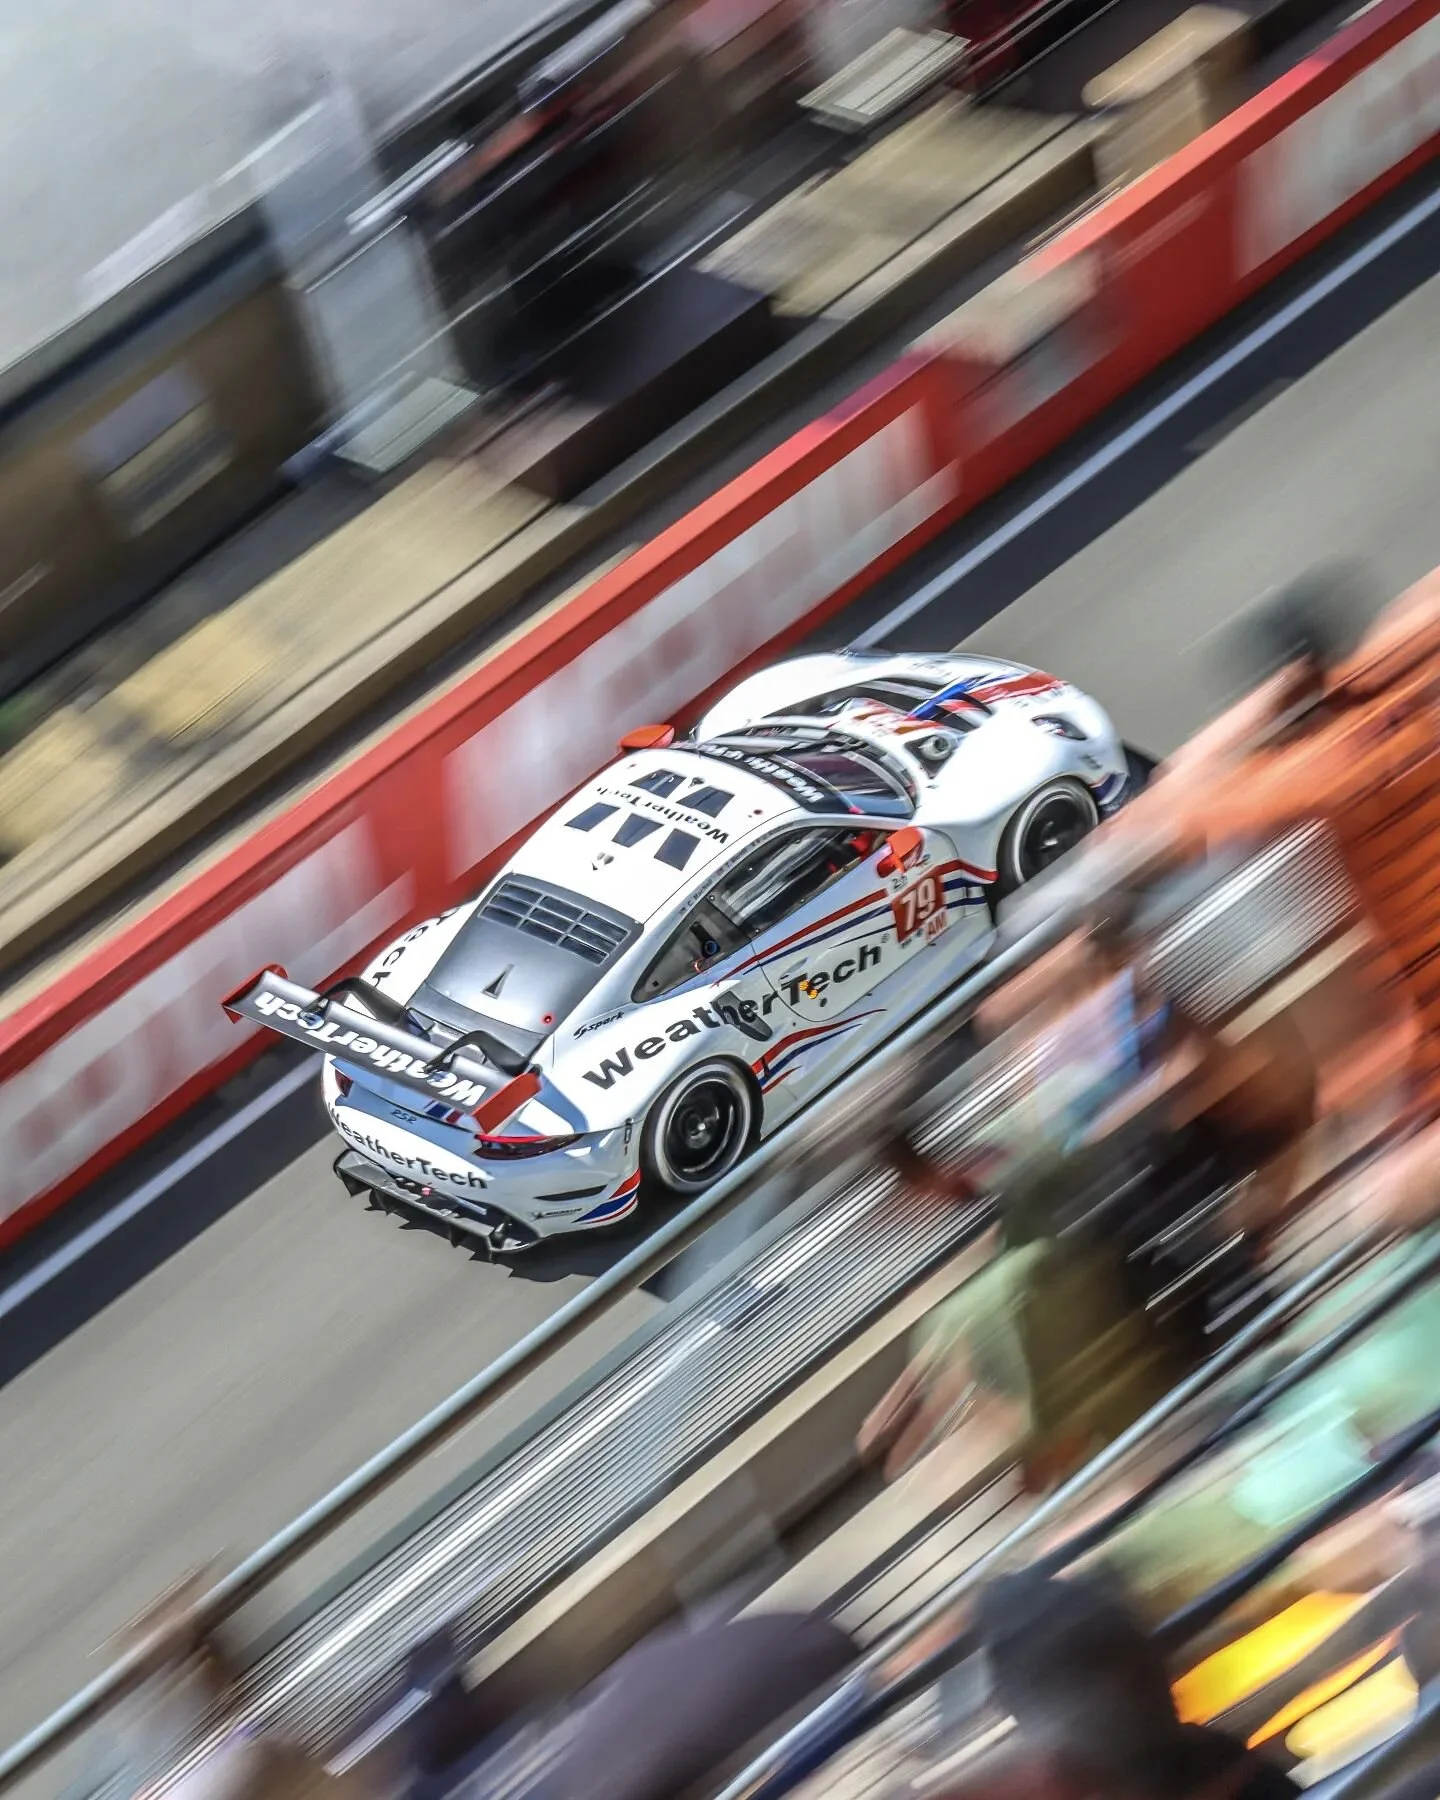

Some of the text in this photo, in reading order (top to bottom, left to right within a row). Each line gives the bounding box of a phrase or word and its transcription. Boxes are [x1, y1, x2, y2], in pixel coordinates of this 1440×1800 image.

[902, 878, 937, 931] 79
[927, 910, 946, 937] AM
[255, 991, 487, 1107] WeatherTech
[582, 942, 882, 1089] WeatherTech
[328, 1101, 488, 1189] WeatherTech
[391, 1108, 417, 1124] RSR
